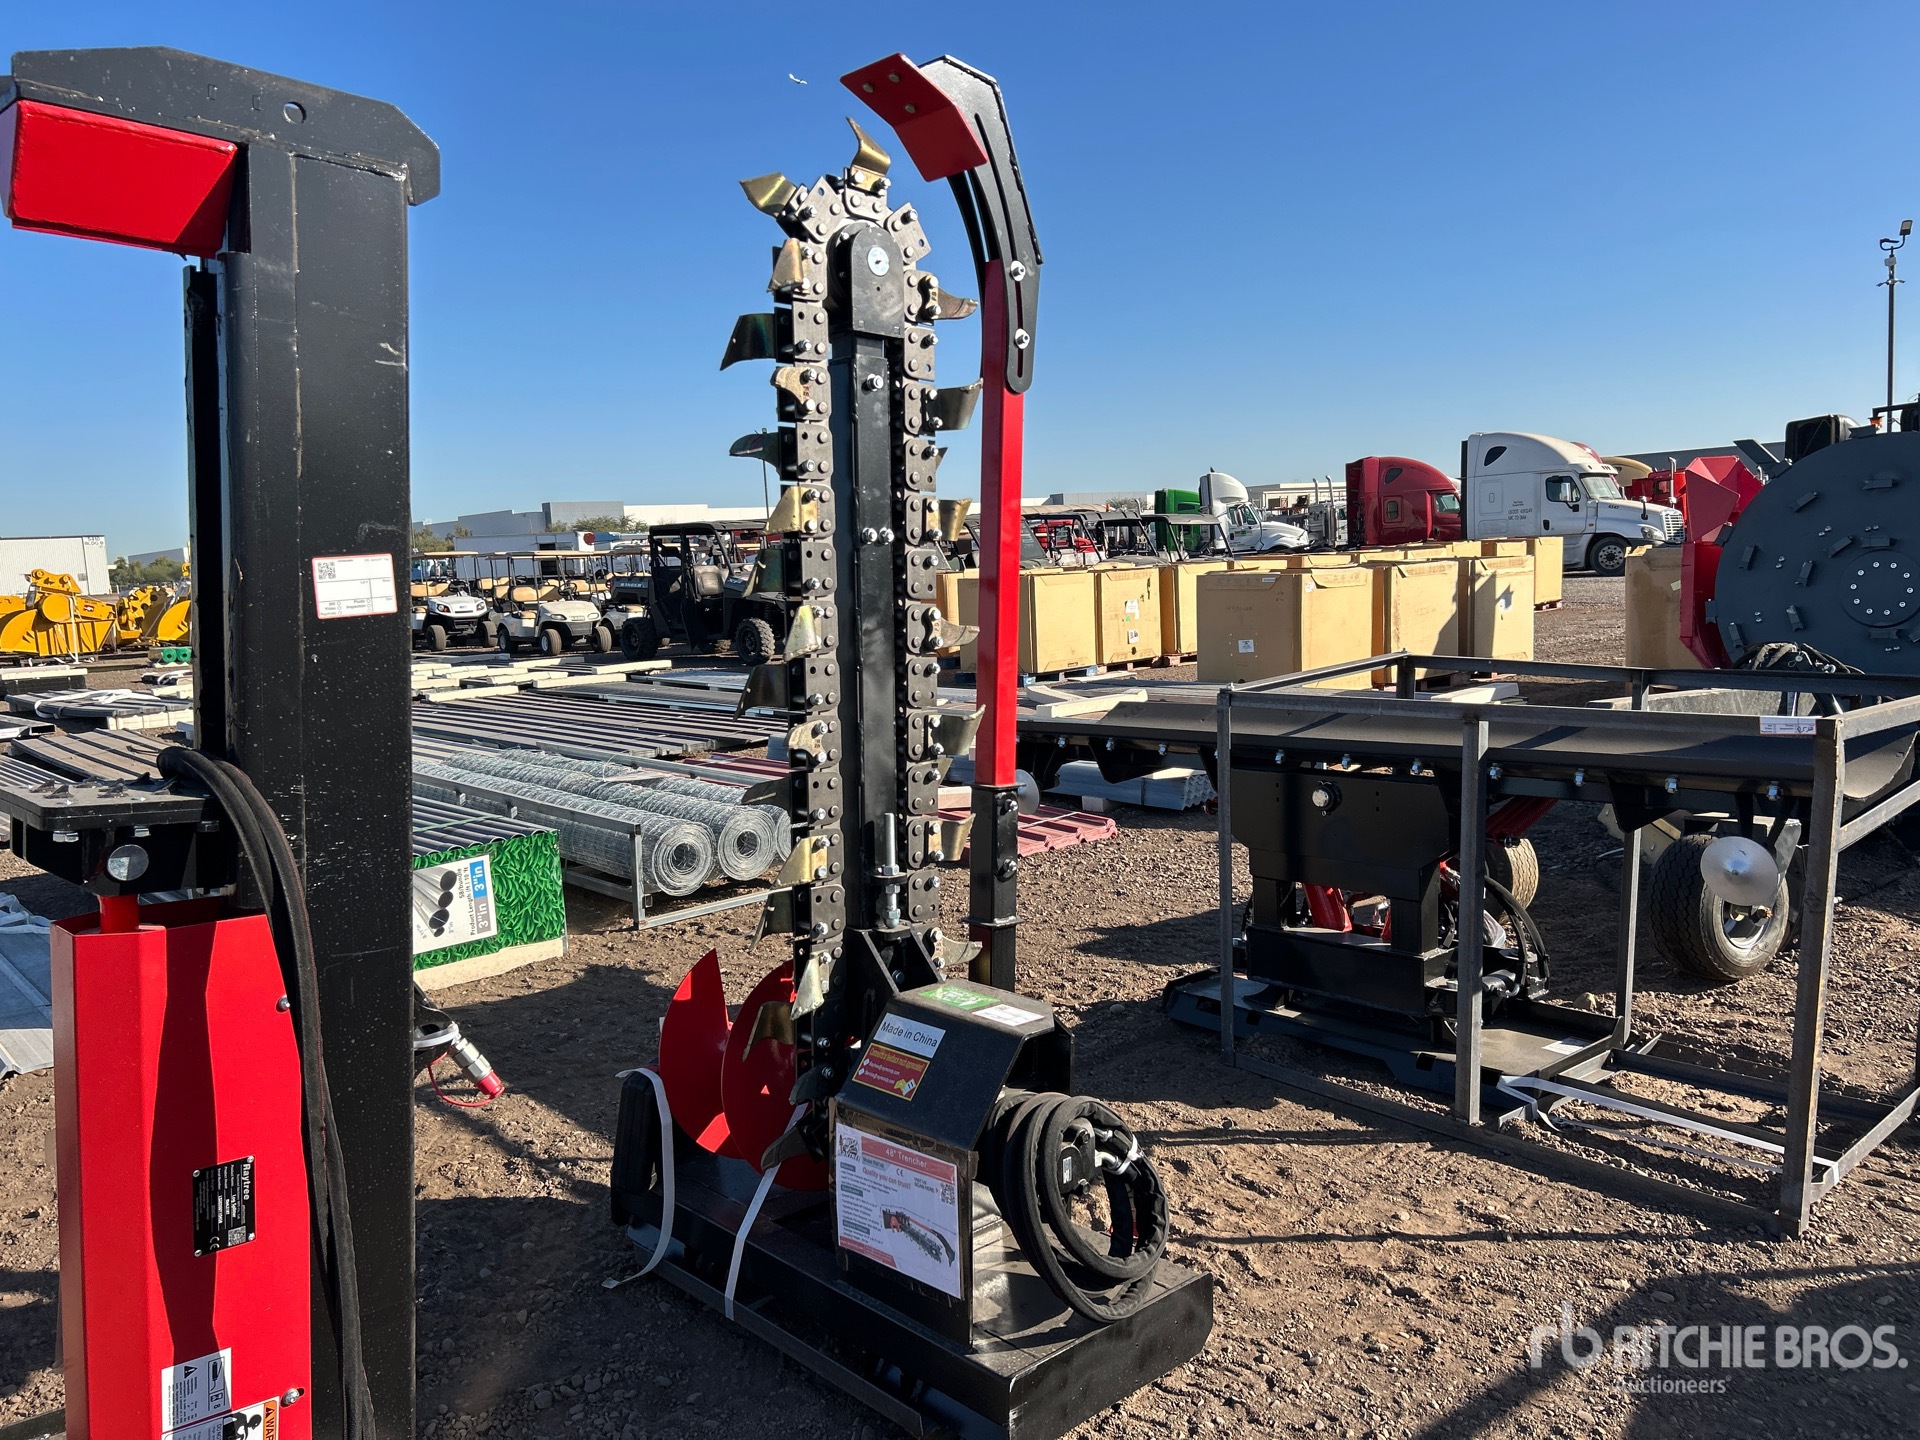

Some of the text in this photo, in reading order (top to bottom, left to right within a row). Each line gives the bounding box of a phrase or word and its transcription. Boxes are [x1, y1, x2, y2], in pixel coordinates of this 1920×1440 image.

[473, 866, 485, 891] 3"in
[478, 903, 488, 928] 3"in
[881, 1022, 937, 1047] Made in China
[898, 1151, 927, 1168] Trencher
[242, 1163, 251, 1200] Raytree
[863, 1167, 879, 1179] Quality
